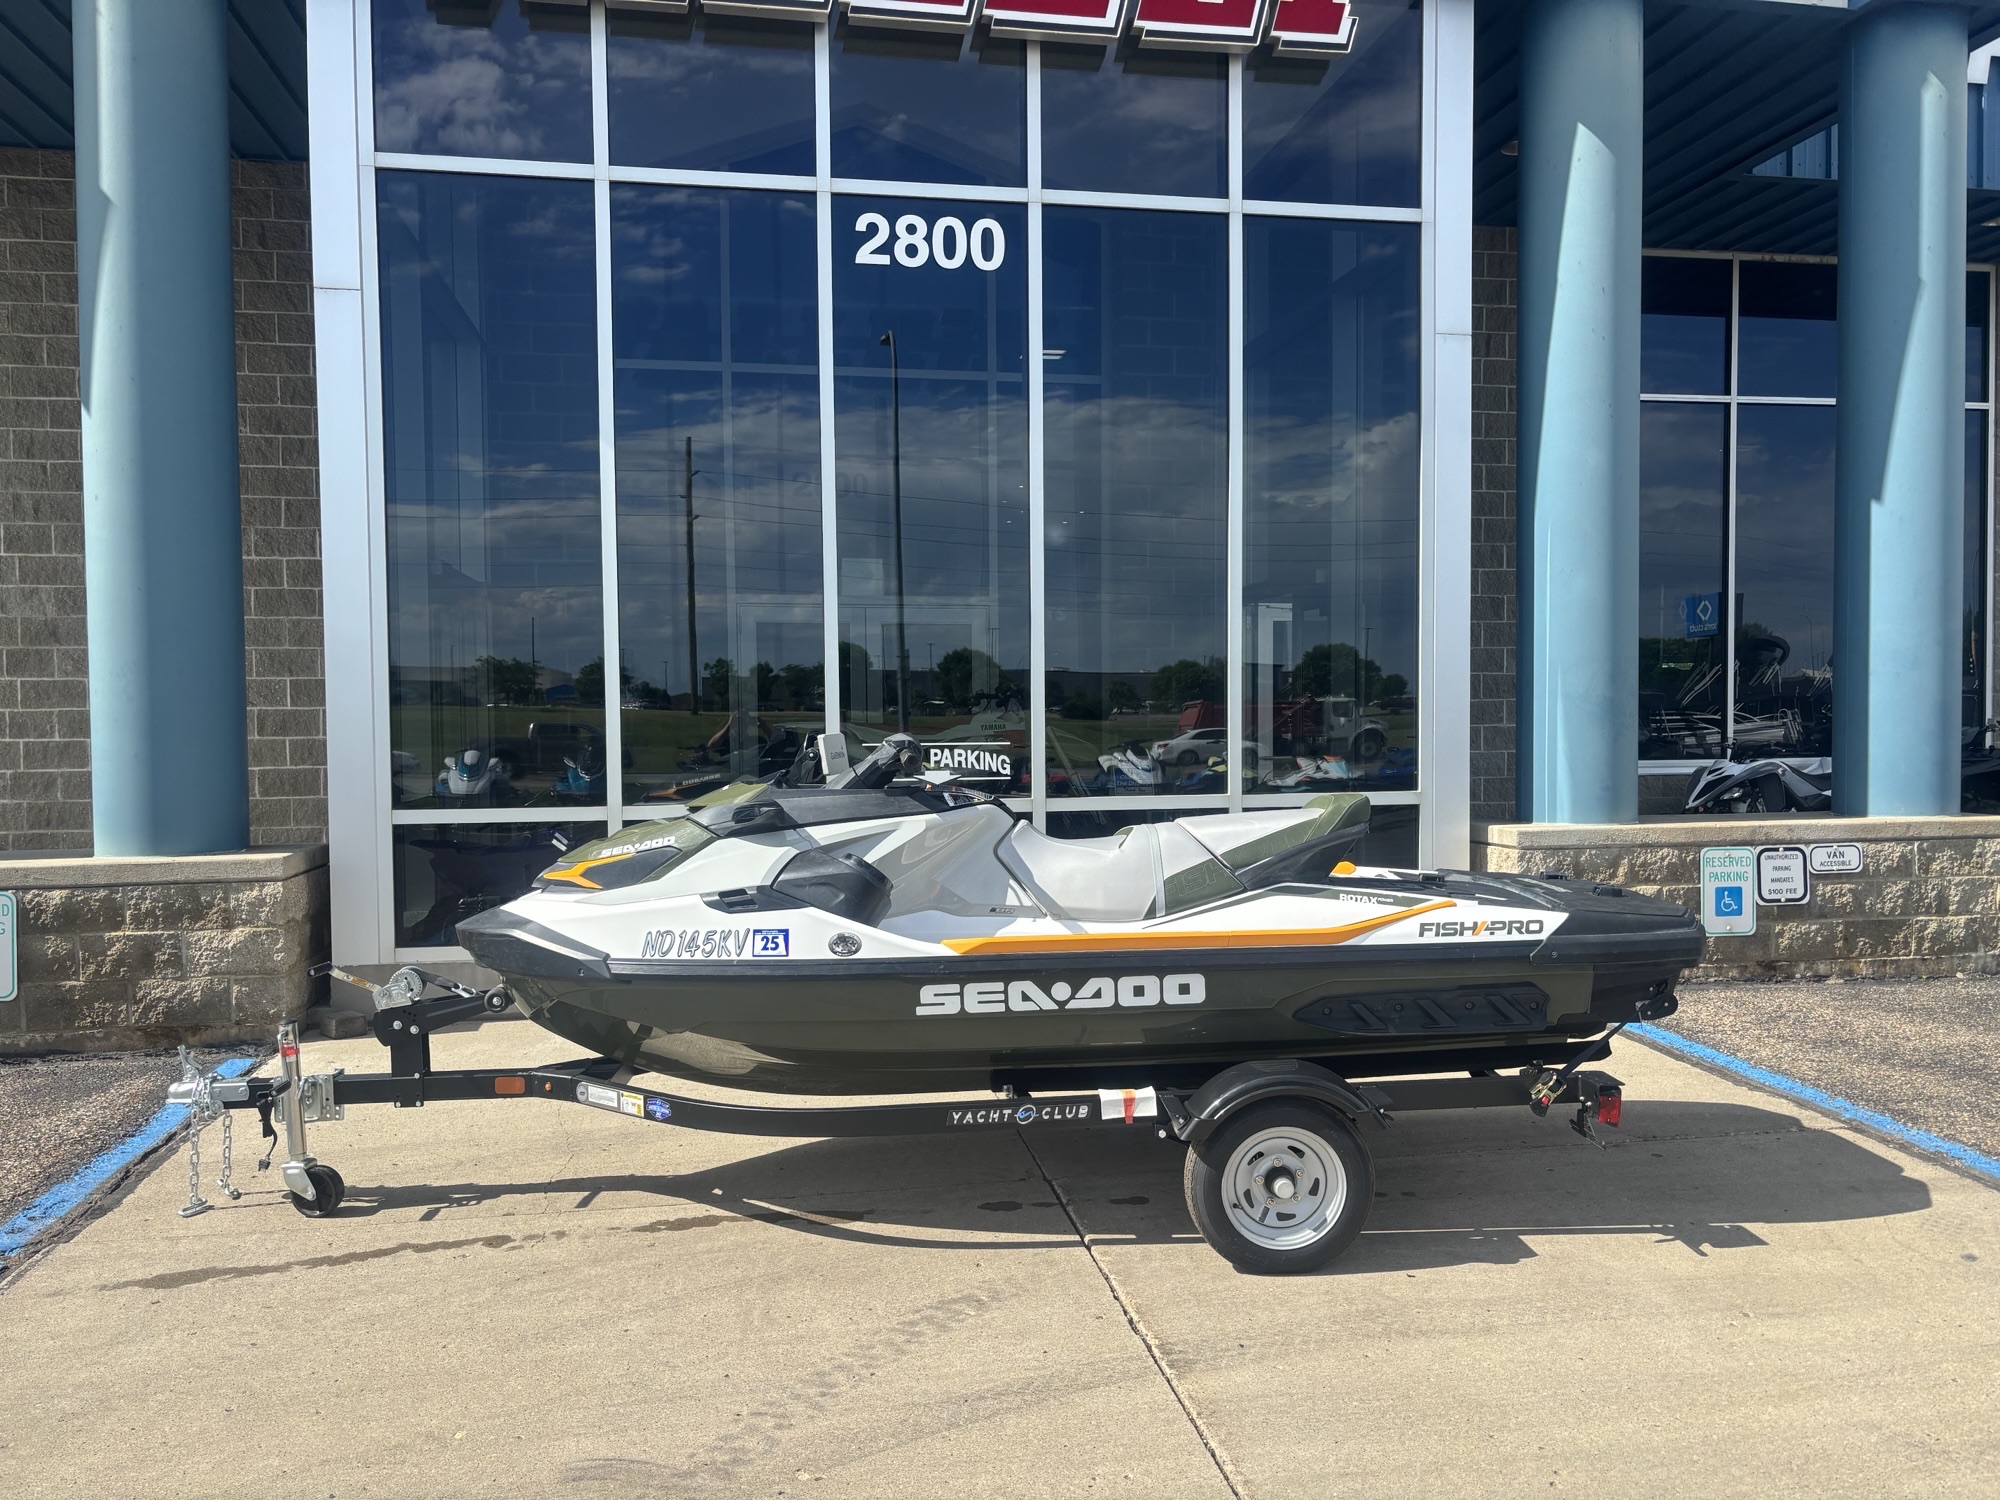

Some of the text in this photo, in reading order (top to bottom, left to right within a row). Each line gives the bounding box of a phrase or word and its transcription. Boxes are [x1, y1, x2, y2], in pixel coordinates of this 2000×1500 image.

[855, 212, 1006, 271] 2800
[980, 723, 1007, 731] YAMAHA
[930, 748, 1011, 775] PARKING
[1826, 851, 1845, 859] VAN
[1705, 856, 1751, 868] RESERVED
[1708, 871, 1749, 882] PARKING
[1340, 893, 1378, 904] ROTAX
[761, 936, 780, 951] 25
[952, 1105, 1089, 1125] YACHT CLUB
